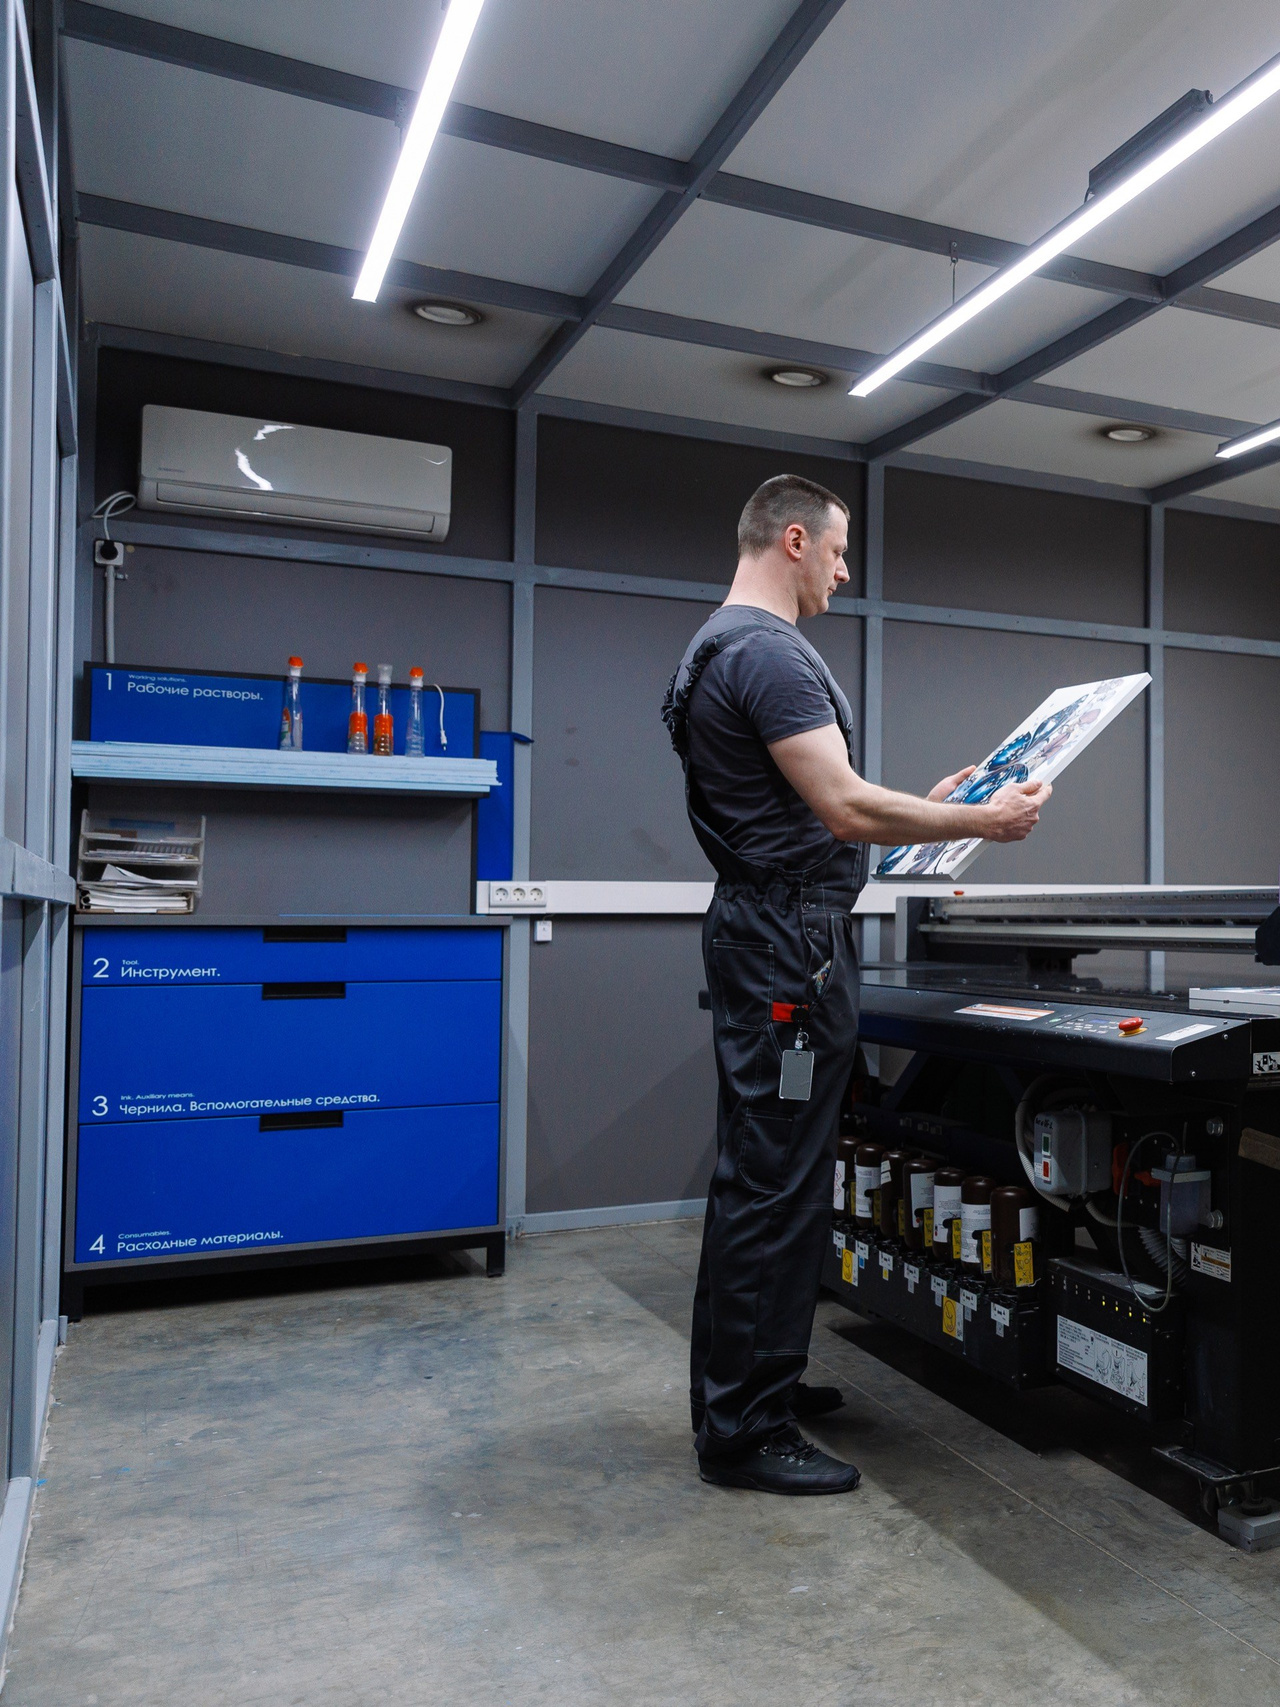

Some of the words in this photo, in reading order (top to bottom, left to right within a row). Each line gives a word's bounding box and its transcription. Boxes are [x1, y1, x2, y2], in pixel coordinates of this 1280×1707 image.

[105, 672, 113, 691] 1
[128, 673, 156, 682] Working
[127, 681, 190, 696] Рабочие
[193, 686, 264, 701] растворы.
[93, 957, 110, 978] 2
[121, 966, 221, 980] Инструмент.
[91, 1095, 109, 1117] 3
[119, 1103, 186, 1116] Чернила.
[189, 1097, 313, 1112] Вспомогательные
[315, 1094, 381, 1106] средства.
[88, 1234, 106, 1255] 4
[117, 1230, 172, 1240] Consumables.
[117, 1237, 197, 1253] Расходные
[200, 1230, 285, 1245] материалы.
